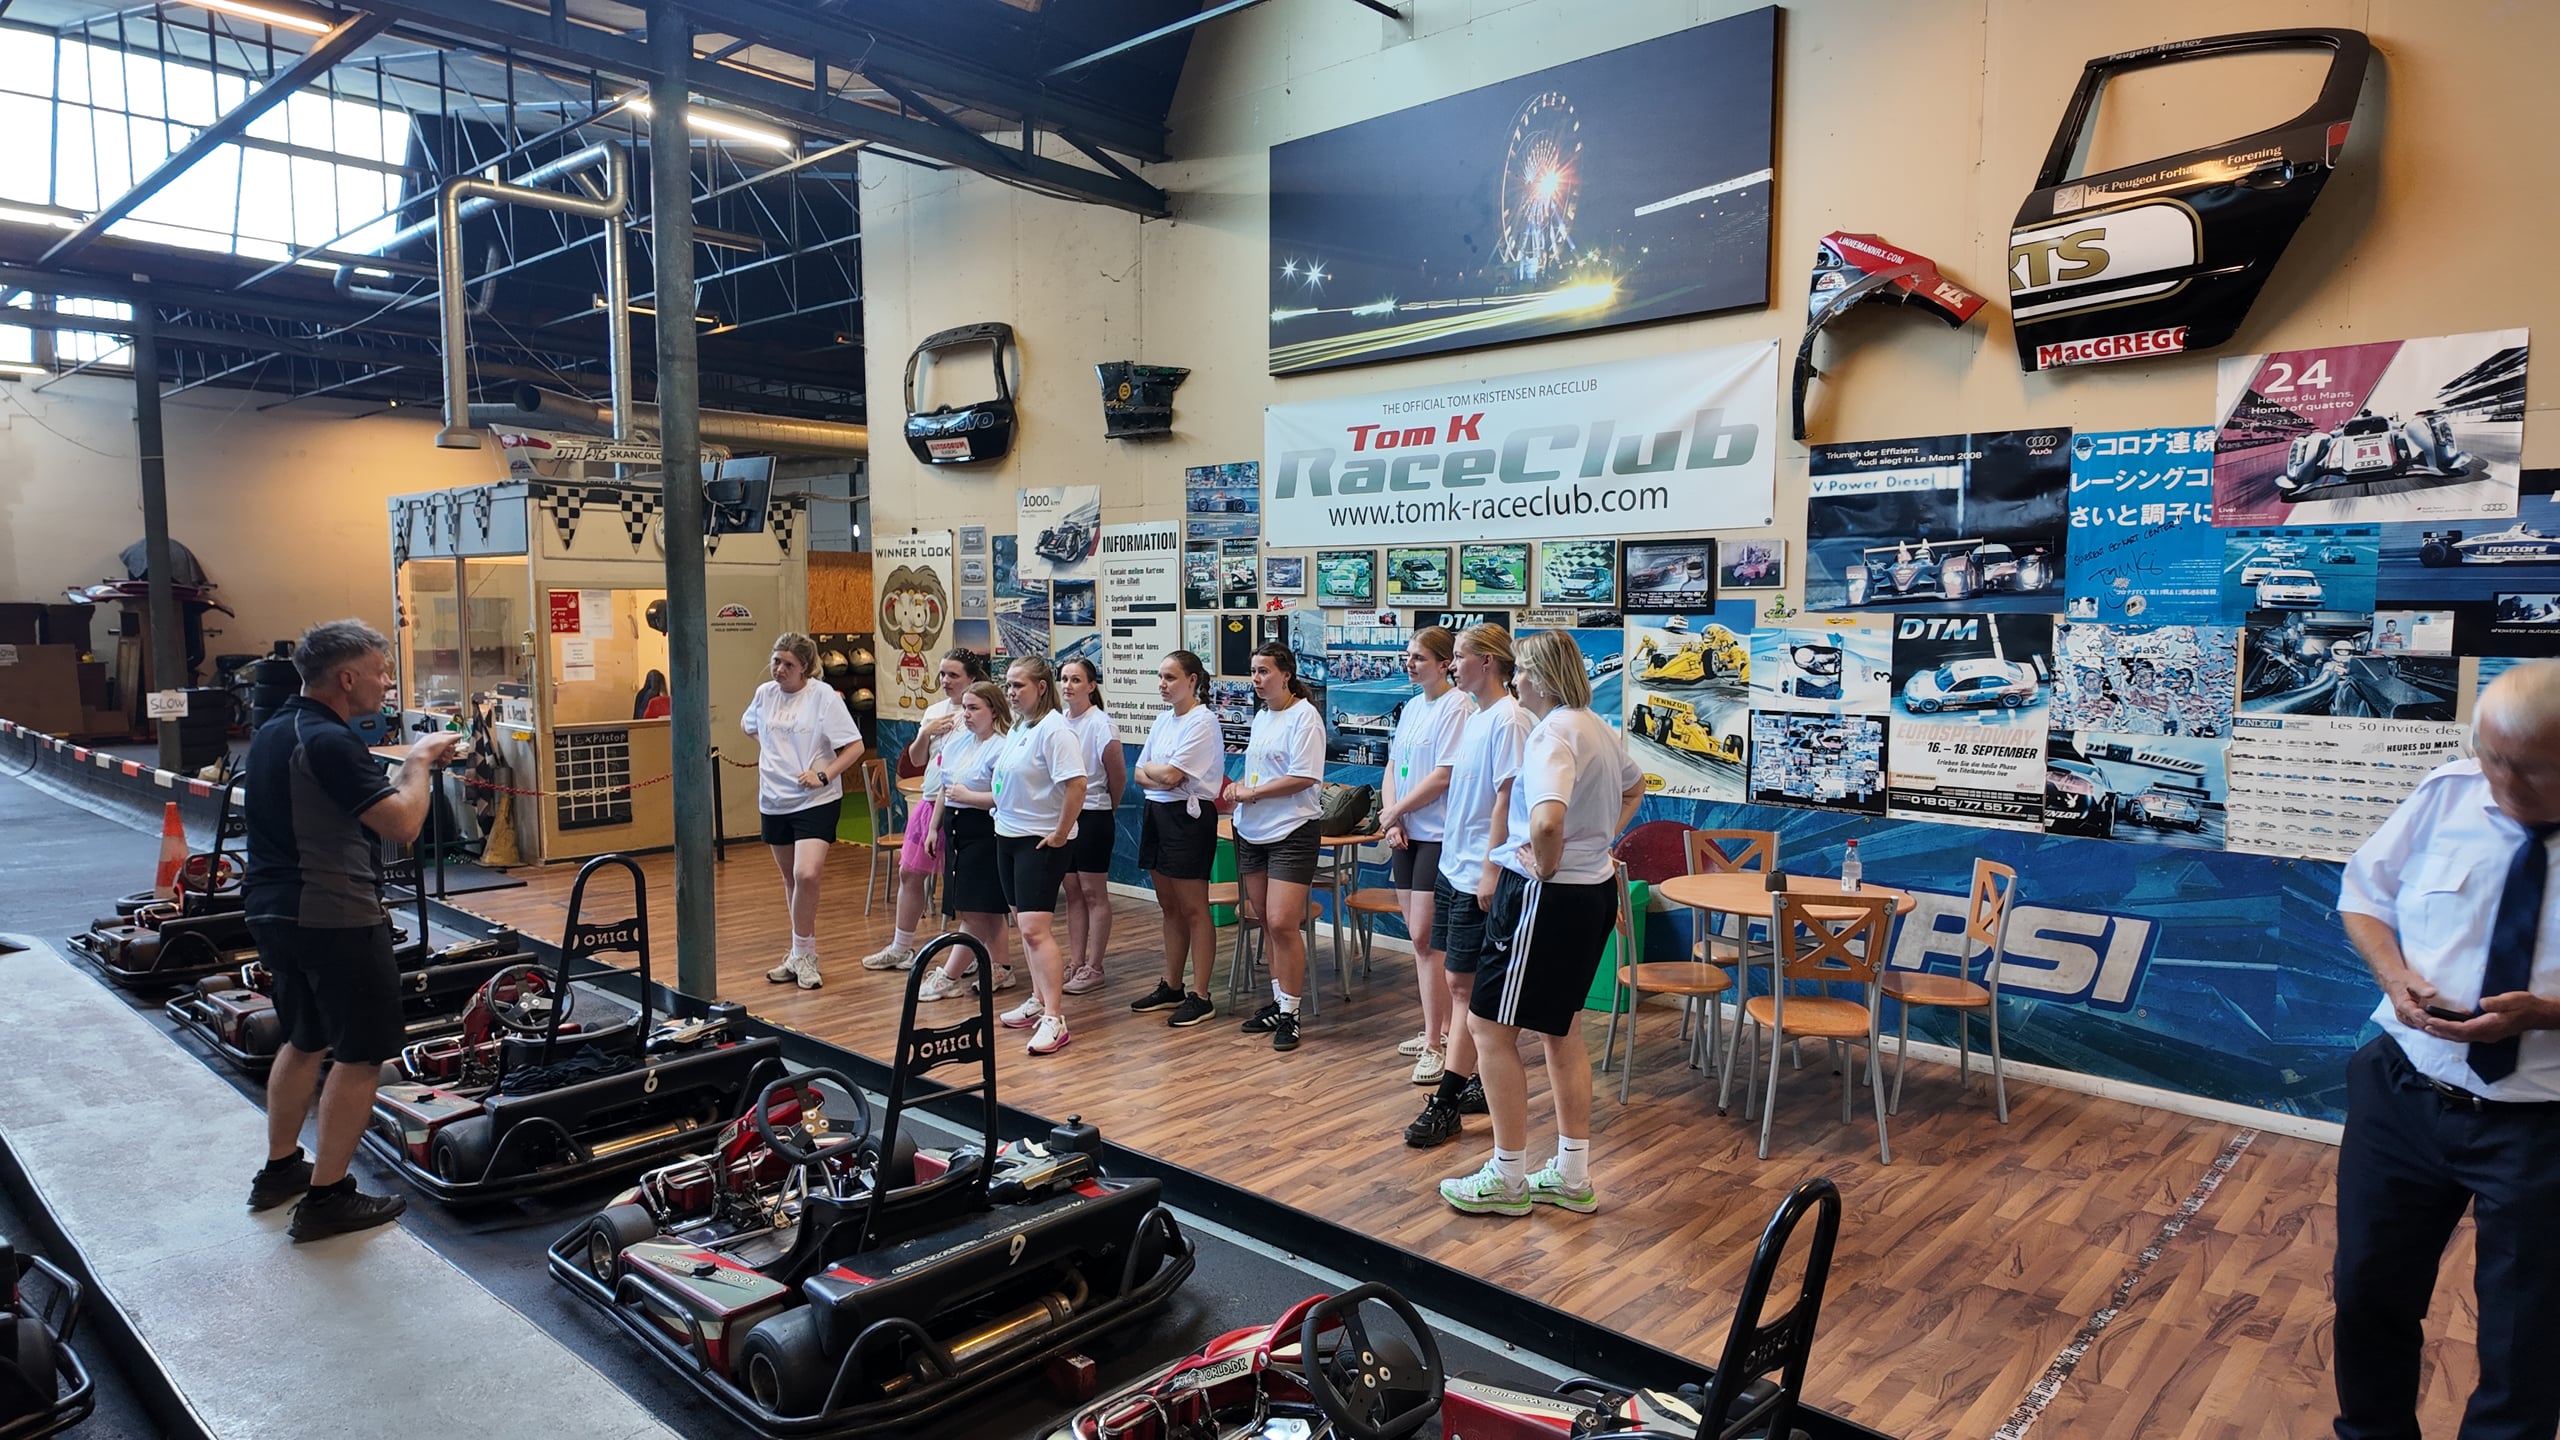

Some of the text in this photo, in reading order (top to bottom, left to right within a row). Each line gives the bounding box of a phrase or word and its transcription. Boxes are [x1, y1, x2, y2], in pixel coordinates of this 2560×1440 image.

[2109, 46, 2155, 61] Peugeot
[2111, 173, 2157, 190] Peugeot
[2226, 145, 2283, 166] Forening
[1837, 235, 1905, 265] LINNEMANNRX.COM
[2263, 358, 2333, 394] 24
[1383, 378, 1598, 415] THE OFFICIAL TOM KRISTENSEN RACECLUB
[2257, 396, 2298, 405] Heures
[2301, 393, 2317, 401] du
[2251, 401, 2355, 415] Home of quattro
[1346, 412, 1485, 452] Tom K
[2029, 448, 2052, 456] Audi
[2095, 431, 2216, 456] コロナ連続
[1275, 407, 1761, 499] RaceClub
[1826, 447, 1919, 460] Triumph der Effizienz
[1879, 458, 1902, 466] siegt
[1914, 455, 1926, 463] Le
[1928, 454, 1956, 462] Mans
[1957, 452, 1982, 460] 2008
[1886, 473, 1936, 488] Diesel
[2071, 466, 2214, 493] レーシングコ
[1023, 495, 1050, 508] 1000
[1328, 483, 1669, 527] www.tomk-raceclub.com
[1102, 531, 1177, 553] INFORMATION
[875, 546, 952, 558] WINNER LOOK
[1438, 614, 1485, 629] DTM
[1897, 618, 1979, 642] DTM
[907, 668, 920, 678] TDI
[150, 698, 186, 711] SLOW
[1118, 724, 1133, 734] ØRSEL
[1896, 722, 2036, 746] EUROSPEEDWAY
[2330, 720, 2462, 736] Les 50 invités des
[1927, 742, 1942, 754] 16.
[1953, 743, 1969, 755] 18.
[1972, 744, 2038, 760] SEPTEMBER
[2386, 742, 2418, 752] HEURES
[2420, 742, 2432, 751] DU
[2434, 740, 2459, 750] MANS
[1936, 758, 1960, 767] Erleben
[1999, 762, 2018, 771] Phase
[2138, 752, 2205, 770] DUNLOP
[1667, 785, 1711, 796] Ask for it
[416, 972, 428, 993] 3
[644, 1068, 658, 1094] 6
[1009, 1233, 1027, 1266] 9
[2004, 1405, 2034, 1438] afstand!
